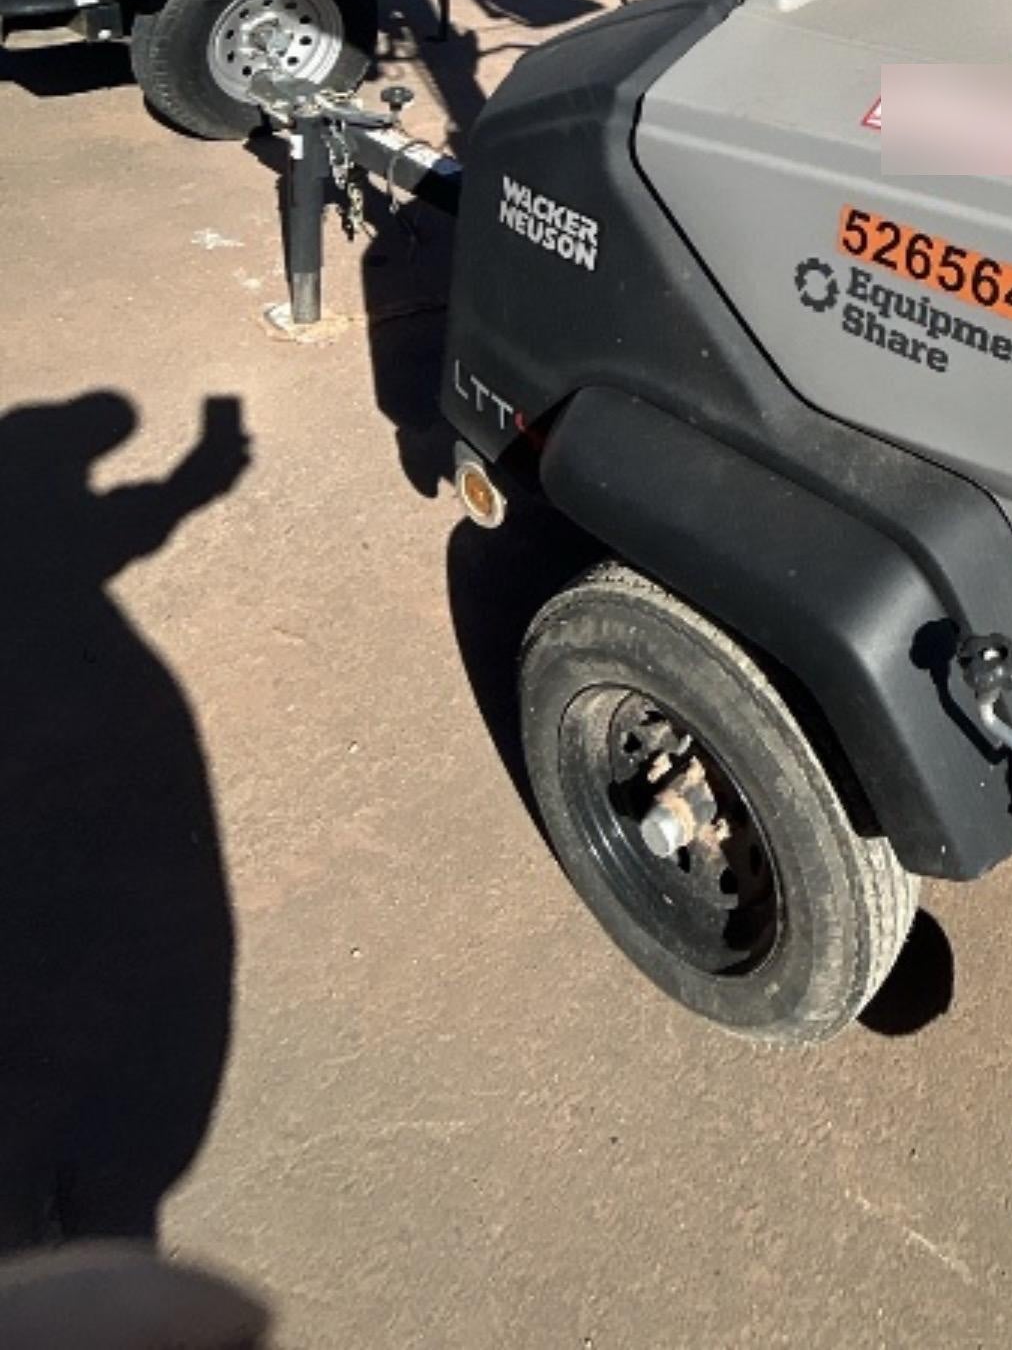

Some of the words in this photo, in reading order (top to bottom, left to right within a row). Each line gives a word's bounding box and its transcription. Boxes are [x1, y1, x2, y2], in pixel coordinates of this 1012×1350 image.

[500, 200, 598, 271] NEUSON
[502, 175, 598, 245] WACKER
[841, 302, 949, 373] Share
